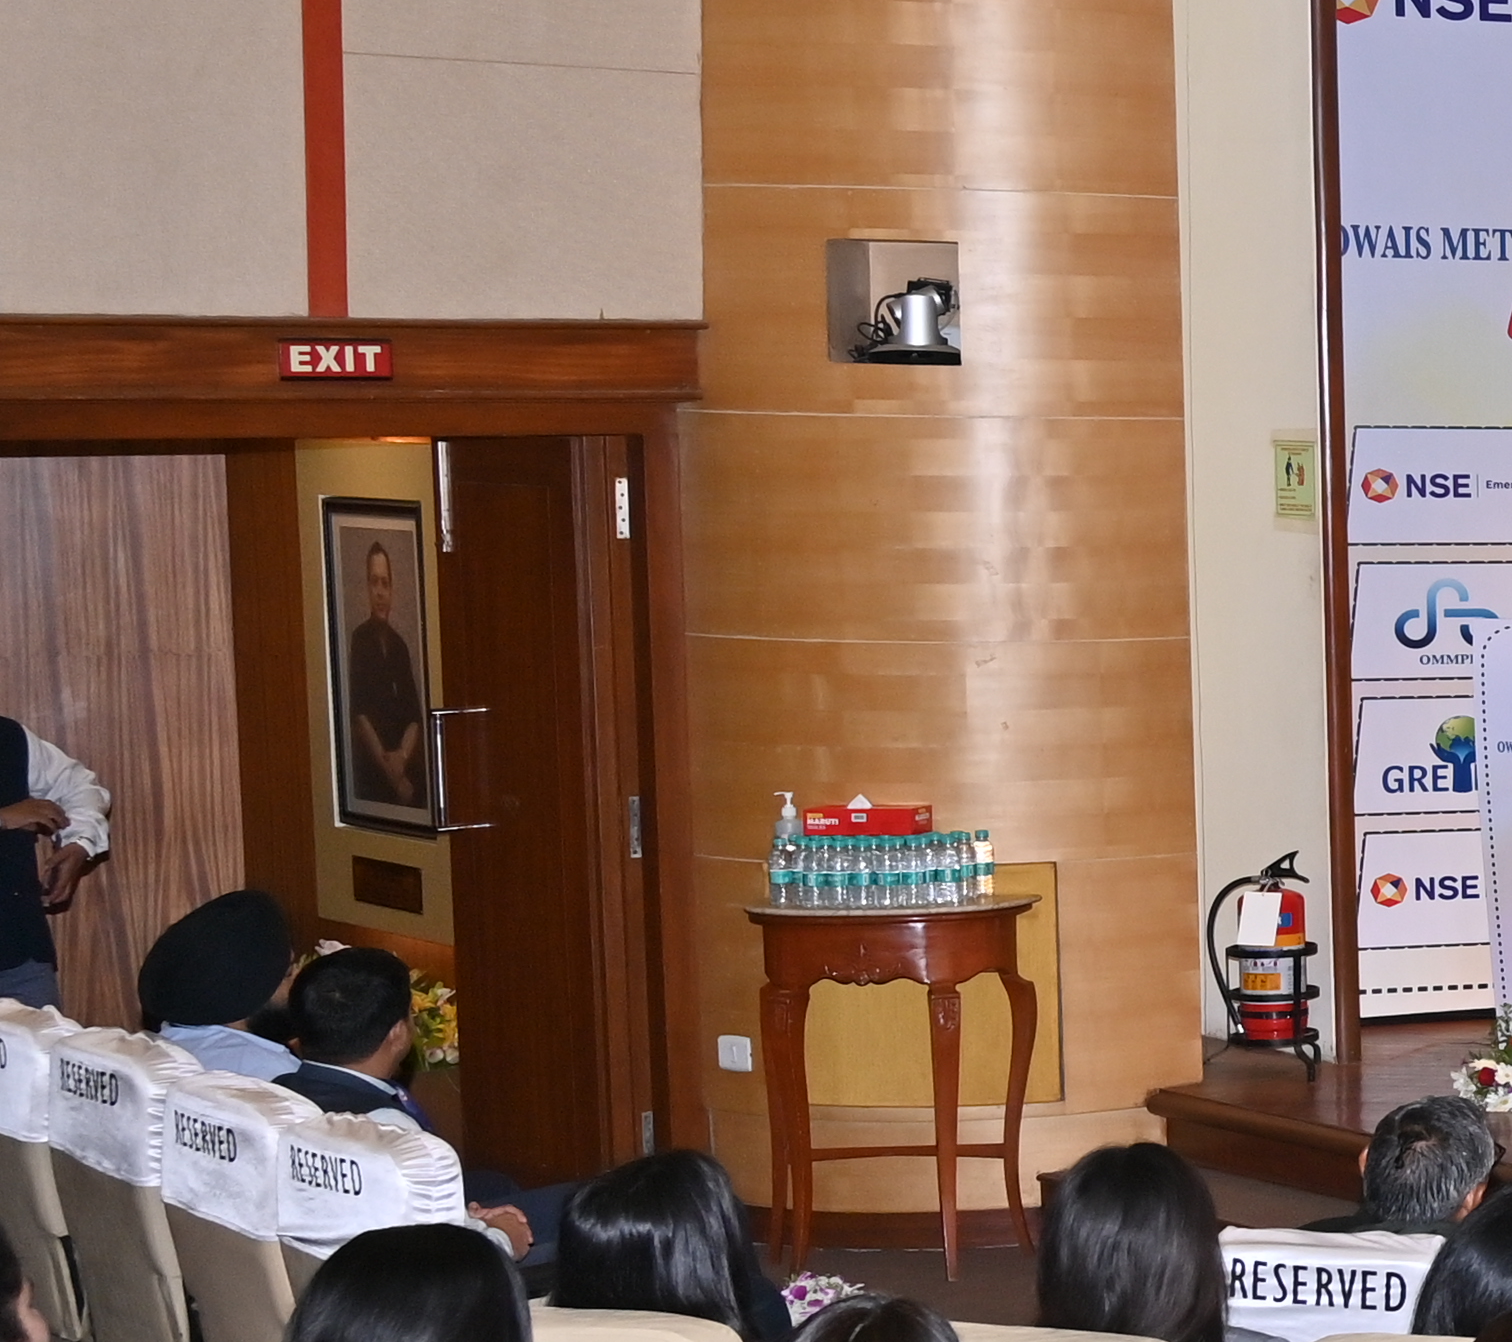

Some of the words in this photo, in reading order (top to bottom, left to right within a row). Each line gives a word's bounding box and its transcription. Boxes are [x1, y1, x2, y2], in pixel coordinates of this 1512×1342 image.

[290, 346, 381, 372] EXIT
[1406, 474, 1471, 498] NSE
[1415, 876, 1479, 900] NSE
[60, 1058, 120, 1106] RESERVED
[174, 1110, 238, 1163] RESERVED
[289, 1144, 363, 1196] RESERVED
[1231, 1258, 1407, 1311] RESERVED
